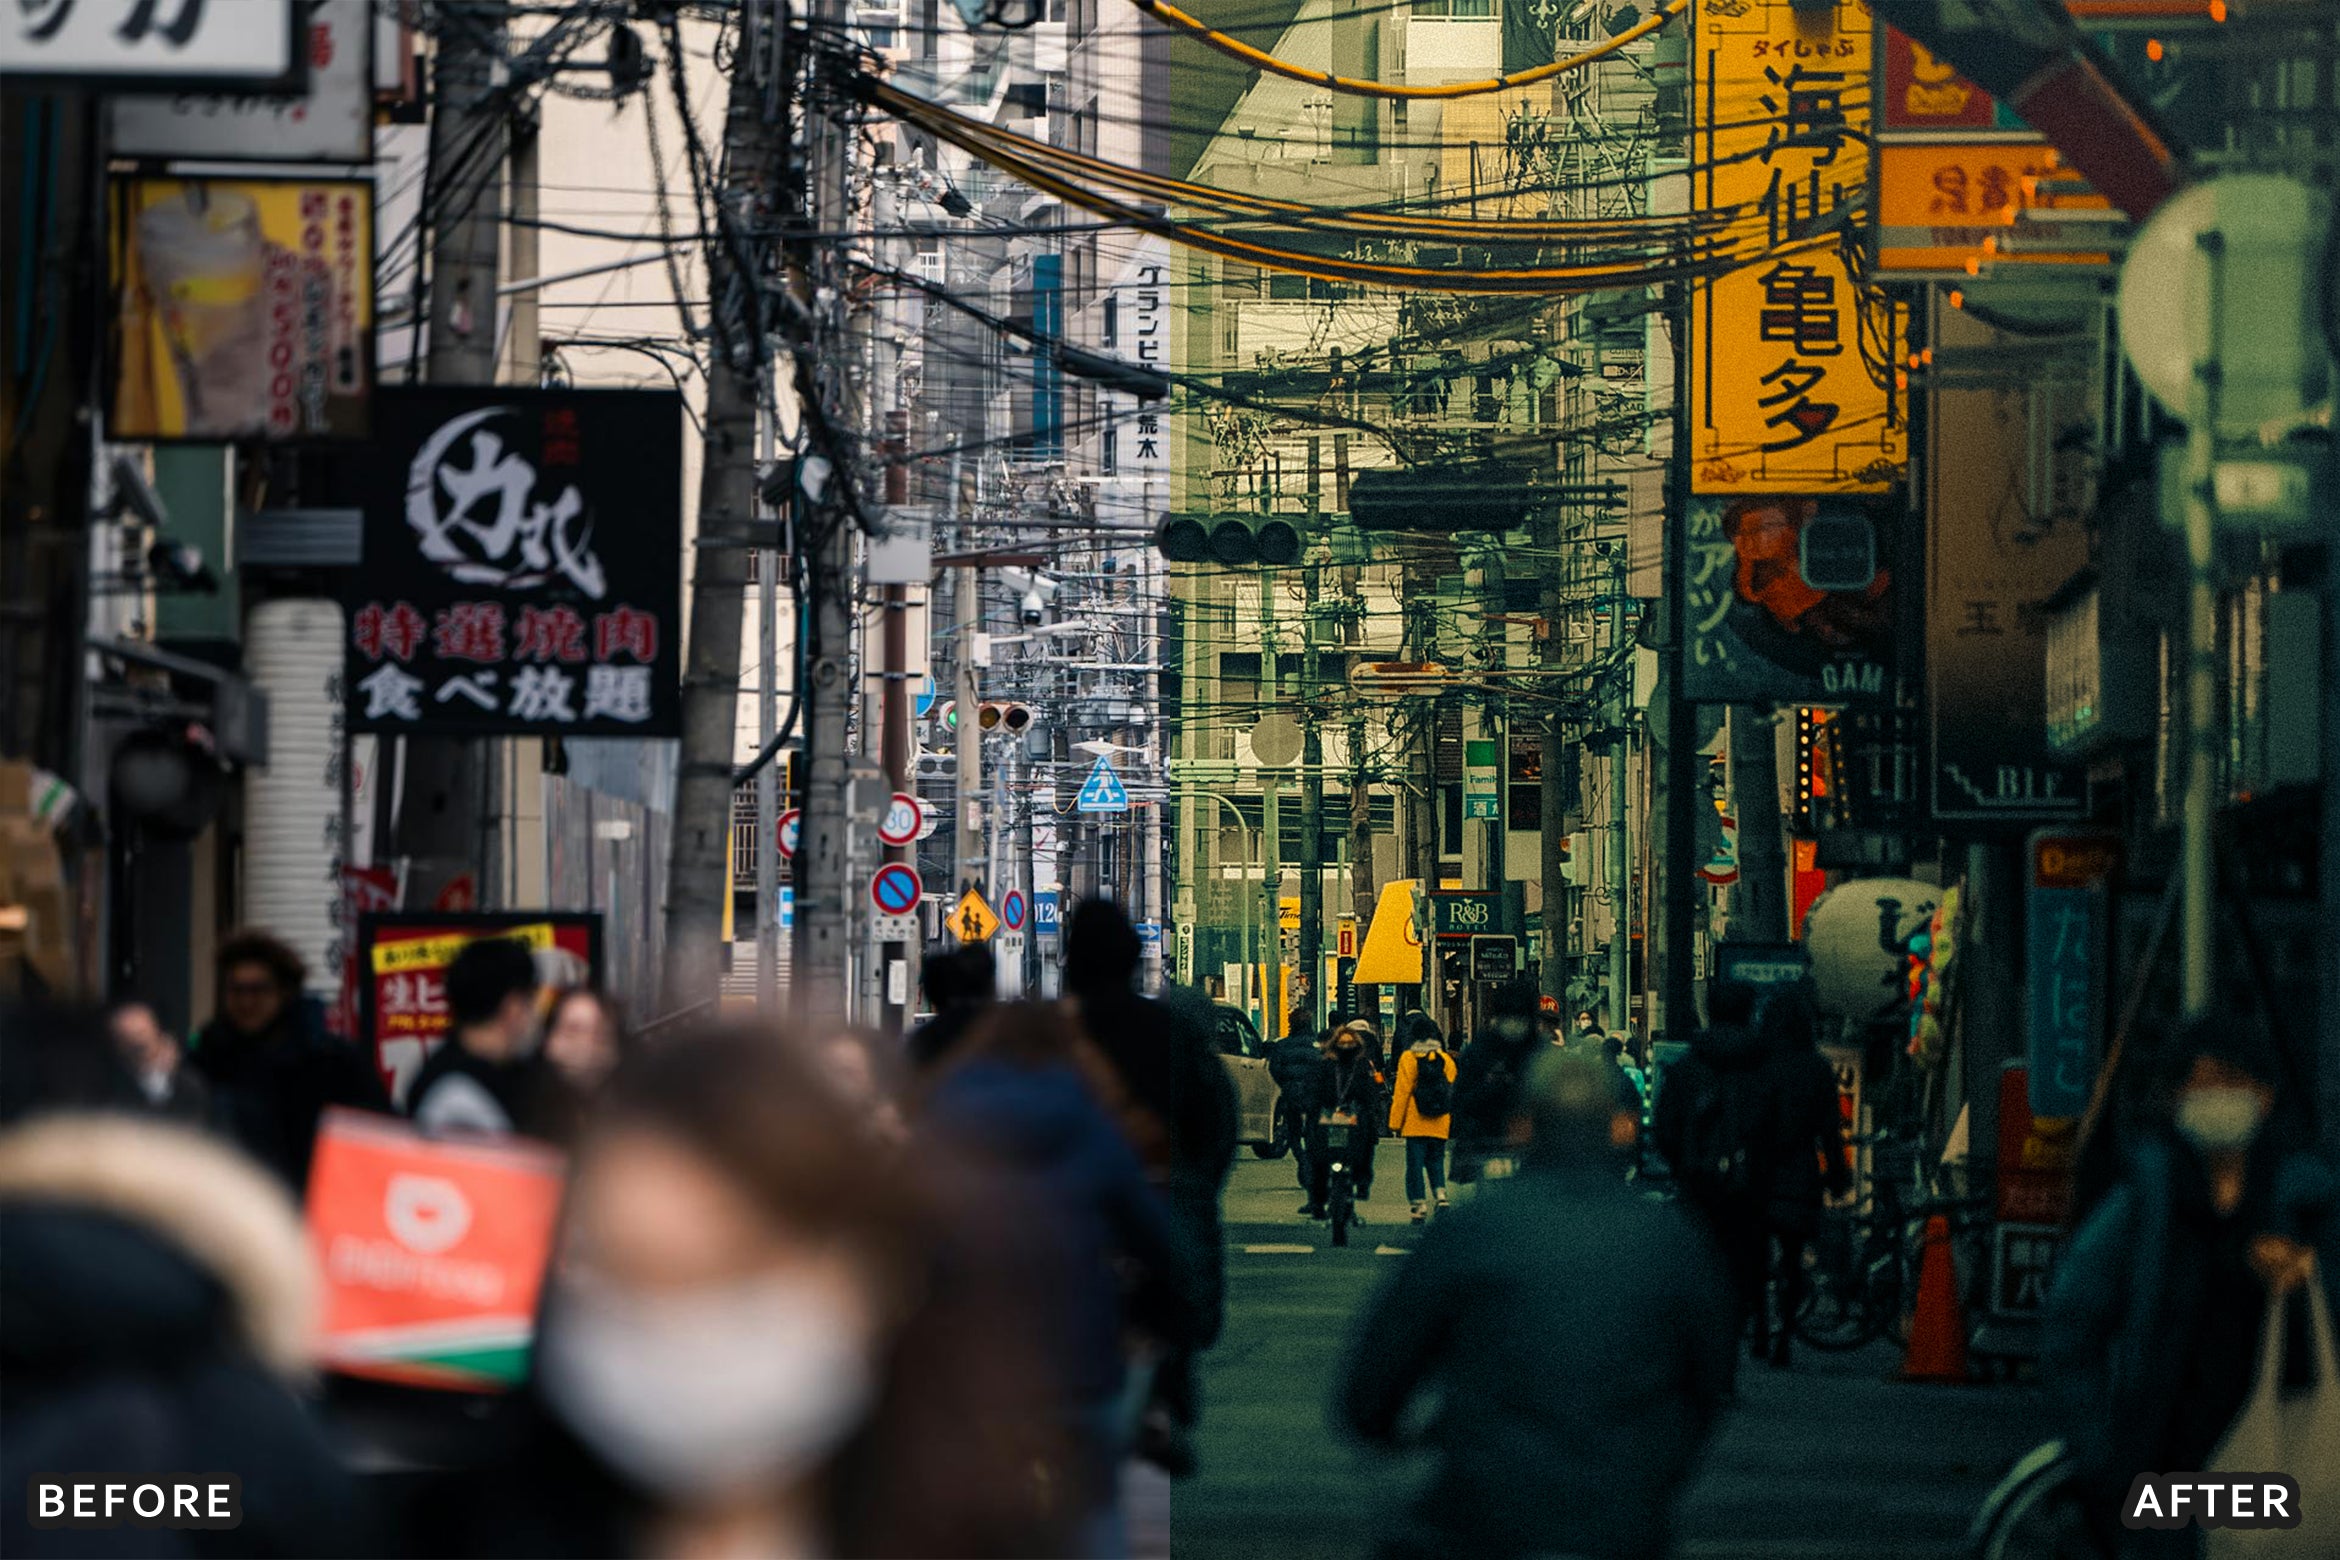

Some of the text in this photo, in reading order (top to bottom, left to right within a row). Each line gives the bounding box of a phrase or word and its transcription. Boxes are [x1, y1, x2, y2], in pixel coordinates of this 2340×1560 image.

[1753, 38, 1856, 58] タイしゃぶ
[1136, 266, 1162, 458] グランビ荒木
[354, 602, 658, 663] 特選焼肉
[357, 663, 655, 722] 食べ放題
[1470, 774, 1498, 784] Famil
[886, 807, 913, 831] 30
[1449, 901, 1489, 925] R&B
